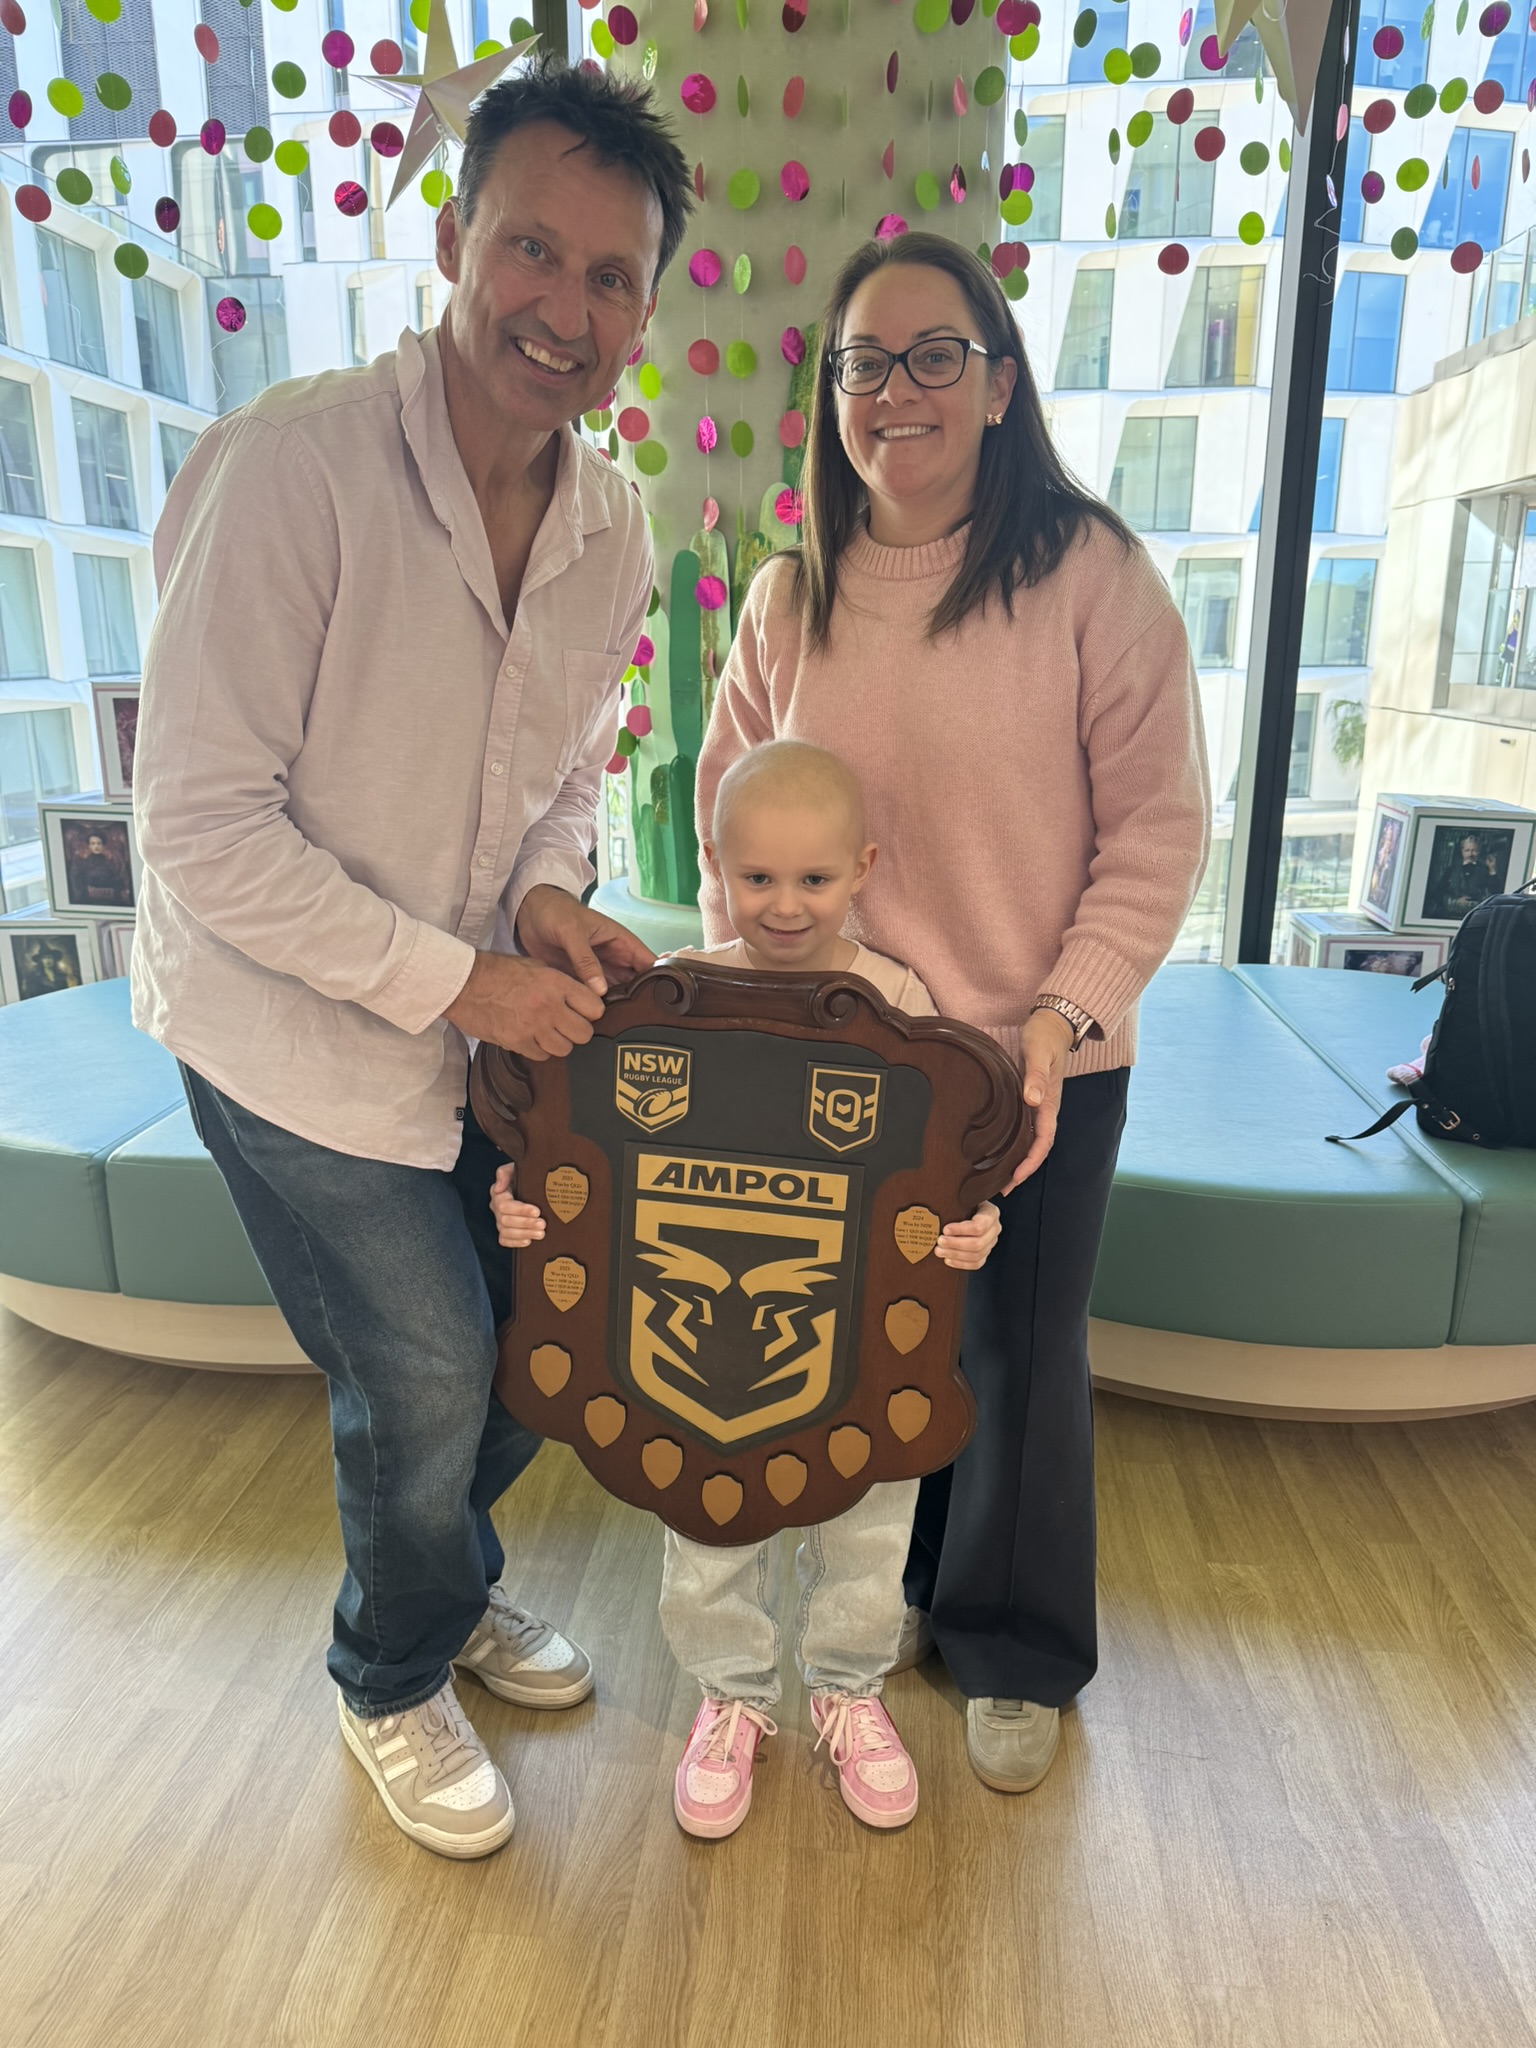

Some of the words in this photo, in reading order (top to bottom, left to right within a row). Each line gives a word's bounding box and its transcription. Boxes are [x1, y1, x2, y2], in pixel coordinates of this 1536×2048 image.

[623, 1051, 685, 1075] NSW
[623, 1072, 650, 1082] RUGBY
[652, 1075, 683, 1085] LEAGUE
[825, 1089, 861, 1132] Q
[650, 1161, 834, 1205] AMPOL
